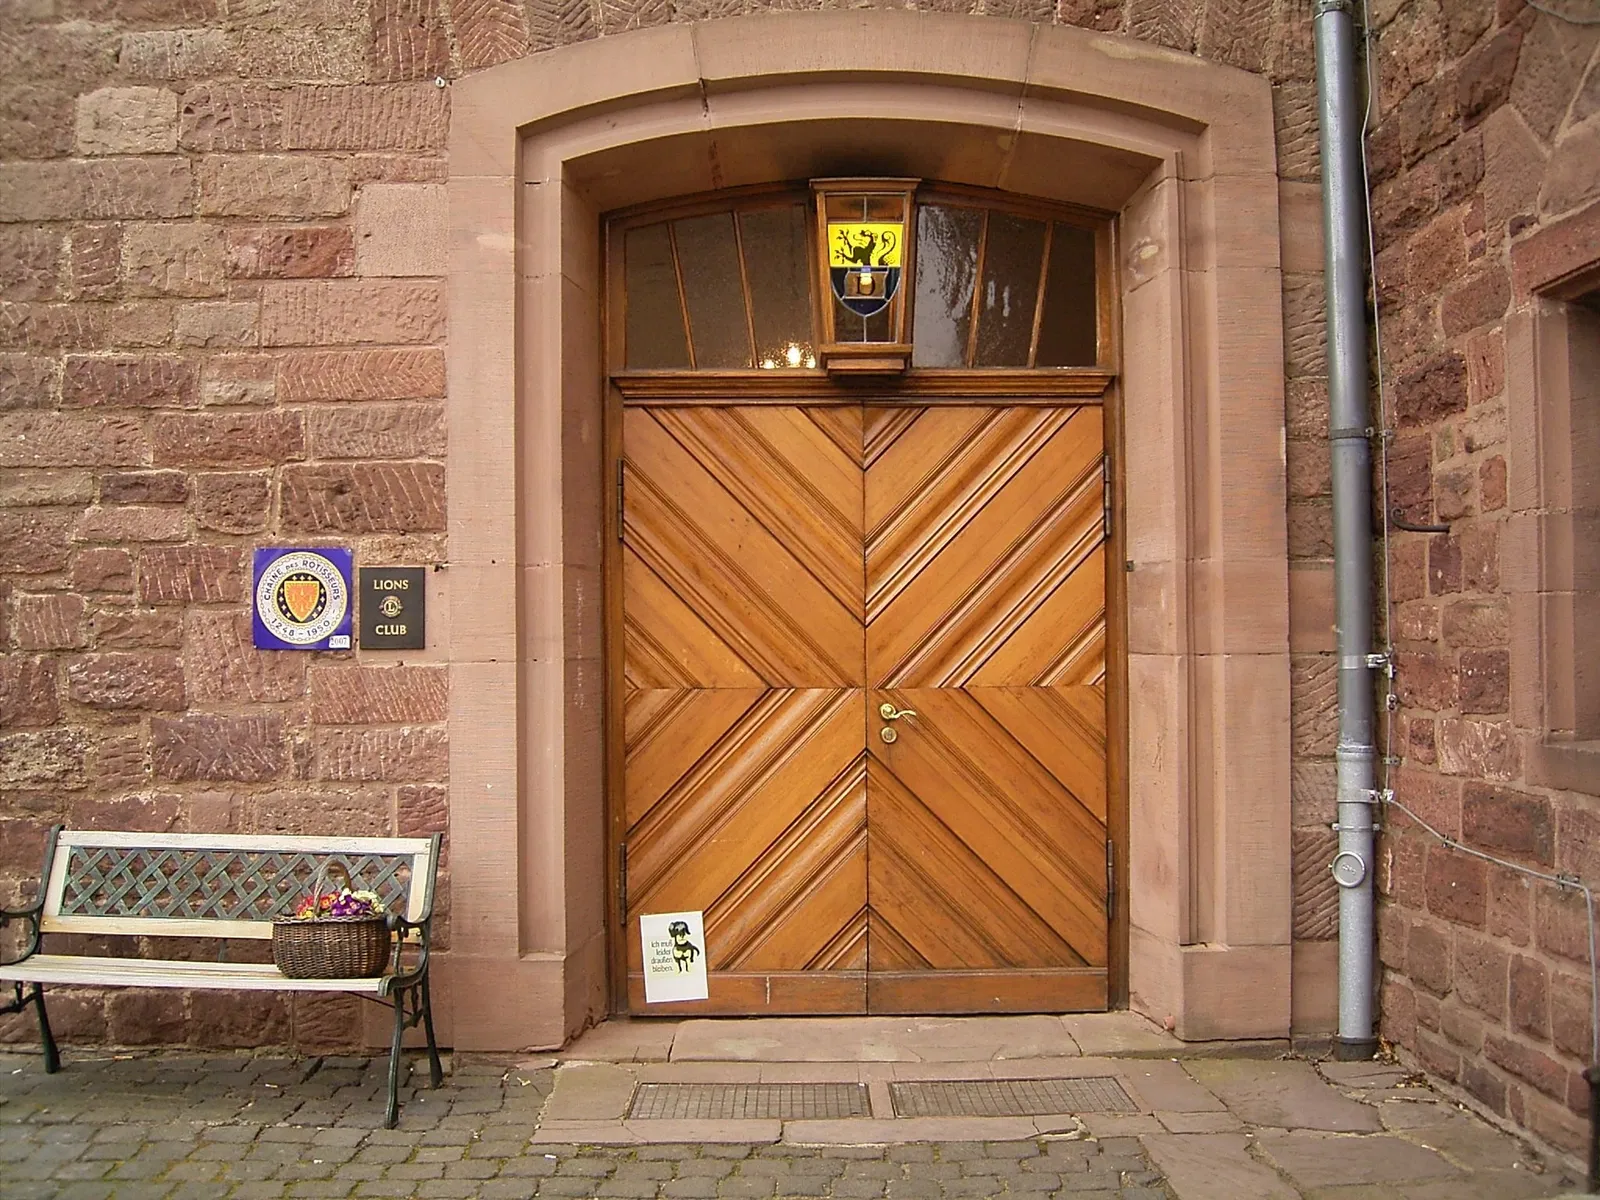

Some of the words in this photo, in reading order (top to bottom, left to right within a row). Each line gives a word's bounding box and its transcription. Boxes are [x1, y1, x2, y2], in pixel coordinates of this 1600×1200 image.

[302, 560, 340, 600] ROTISSEURS
[373, 579, 409, 590] LIONS
[375, 624, 407, 635] CLUB
